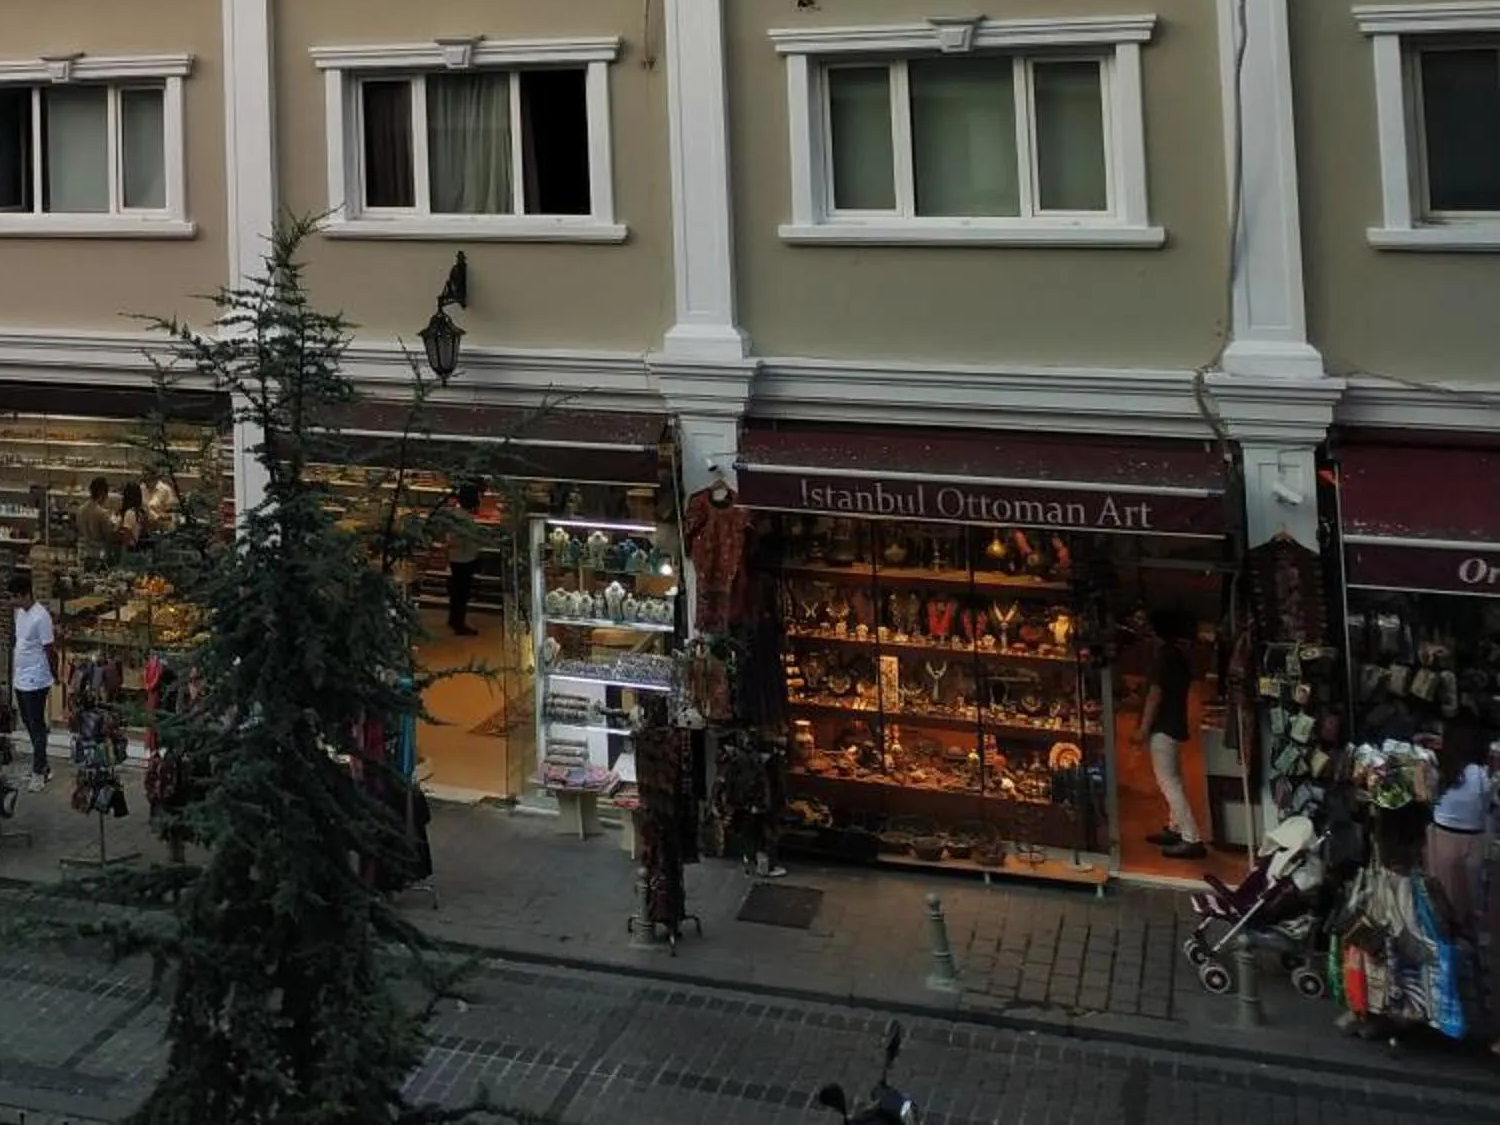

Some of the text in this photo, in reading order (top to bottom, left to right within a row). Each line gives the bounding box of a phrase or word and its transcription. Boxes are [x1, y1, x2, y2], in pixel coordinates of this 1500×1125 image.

[800, 478, 1154, 528] Istanbul Ottoman Art
